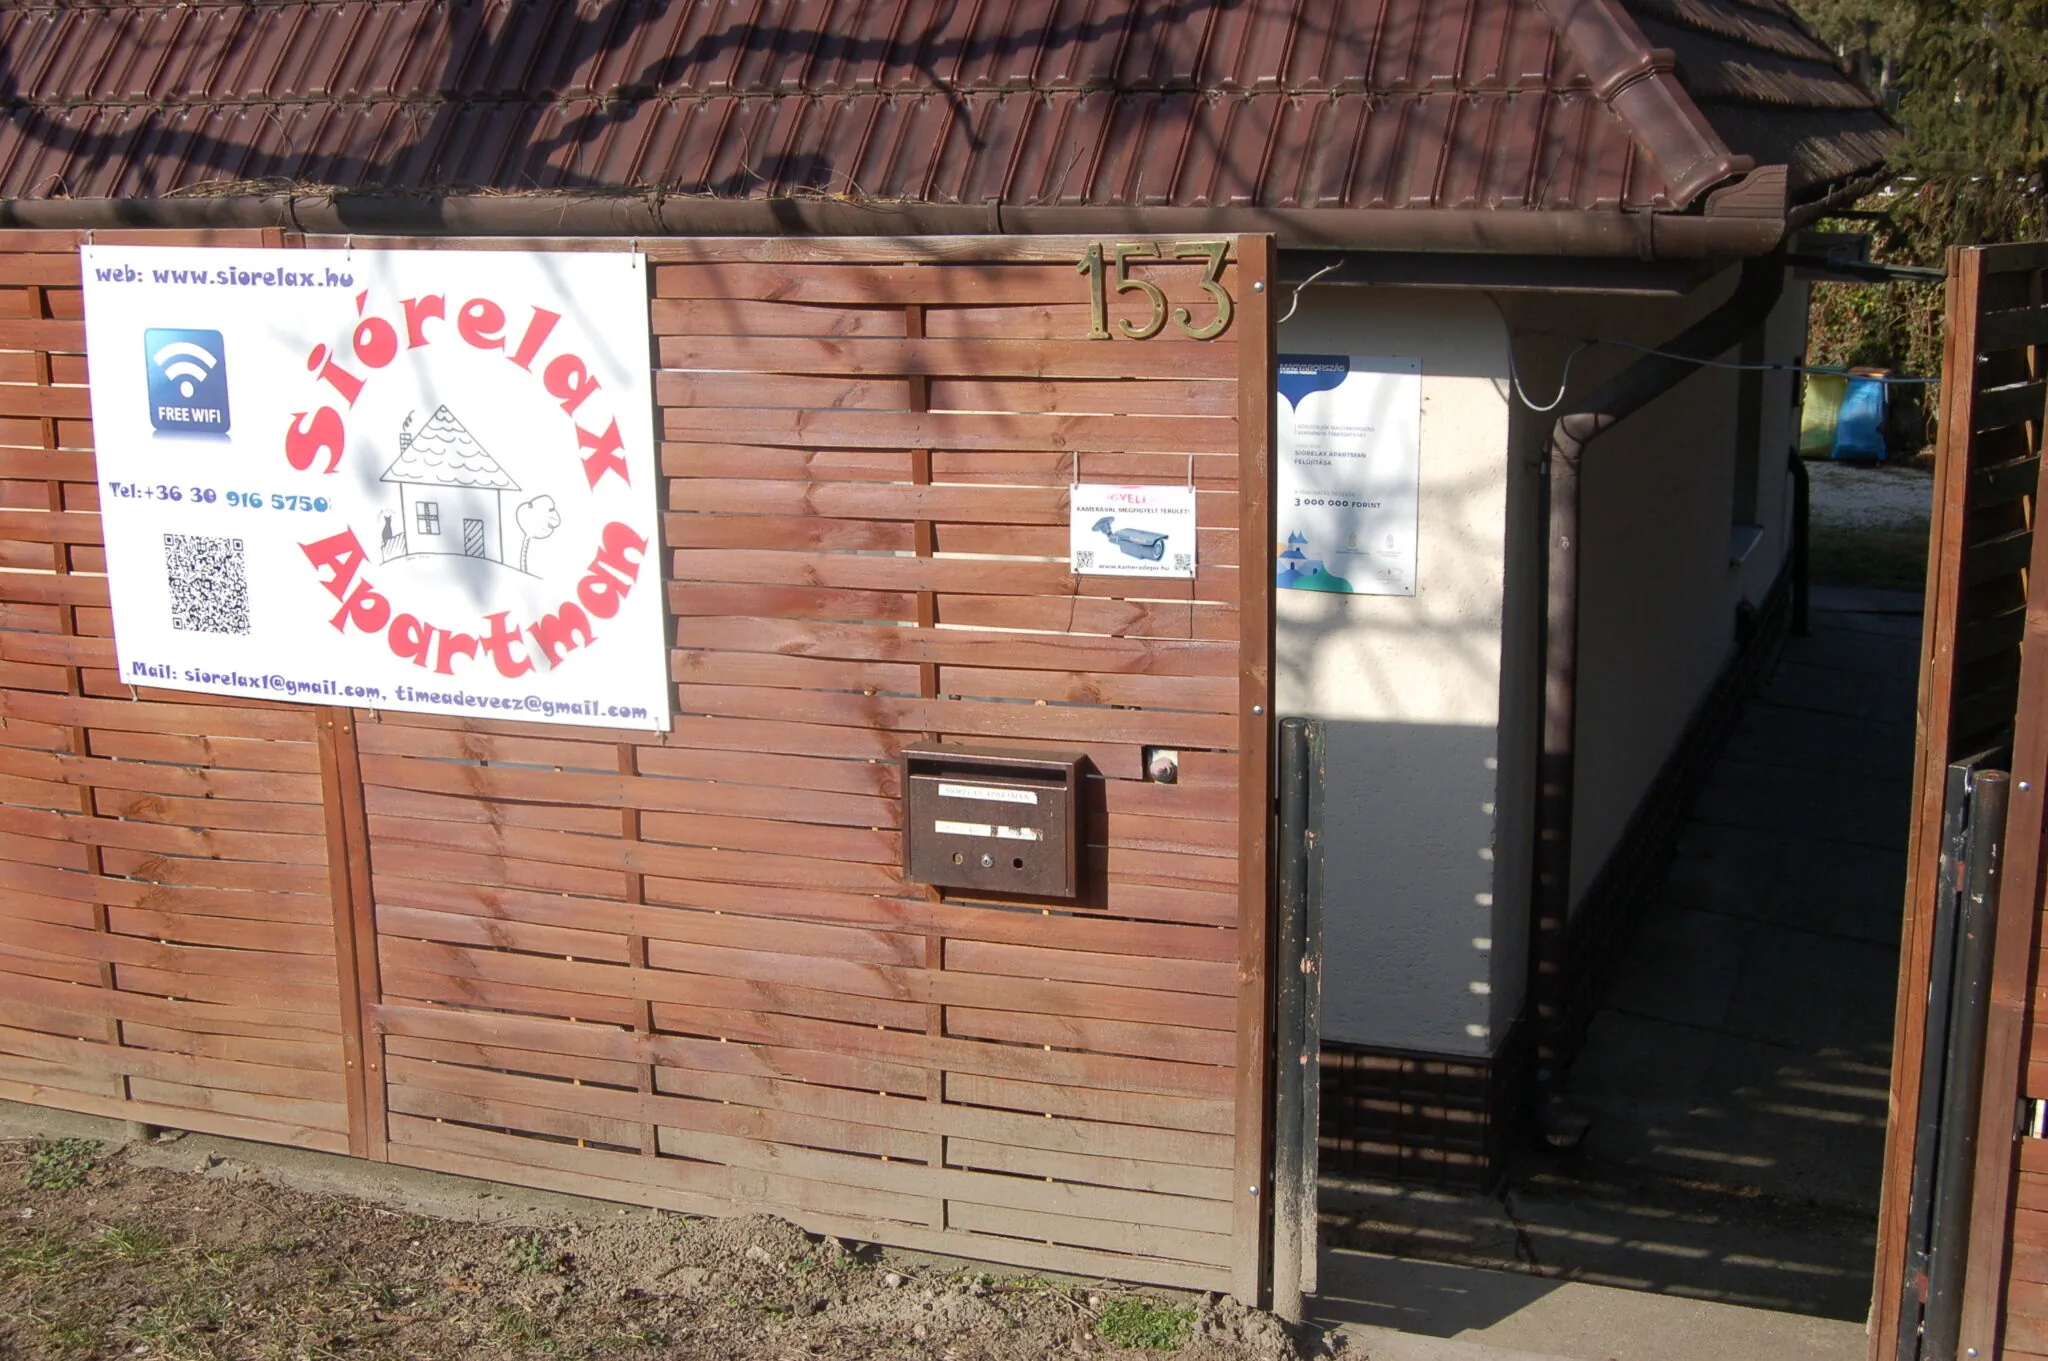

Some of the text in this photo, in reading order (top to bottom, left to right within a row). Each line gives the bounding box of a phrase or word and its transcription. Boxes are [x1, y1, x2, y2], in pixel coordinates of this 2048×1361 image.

[95, 264, 354, 288] web: www.siorelax.hu
[1076, 240, 1231, 341] 153
[285, 289, 632, 493] Siórelax
[158, 407, 221, 423] FREE WIFI
[190, 487, 217, 503] 30
[226, 491, 263, 508] 916
[271, 494, 329, 513] 5750
[1294, 498, 1381, 509] 3 000 000 FORINT
[297, 520, 649, 679] Apartman
[132, 661, 177, 680] Mail:
[395, 685, 647, 720] timeadevecz@gmail.com
